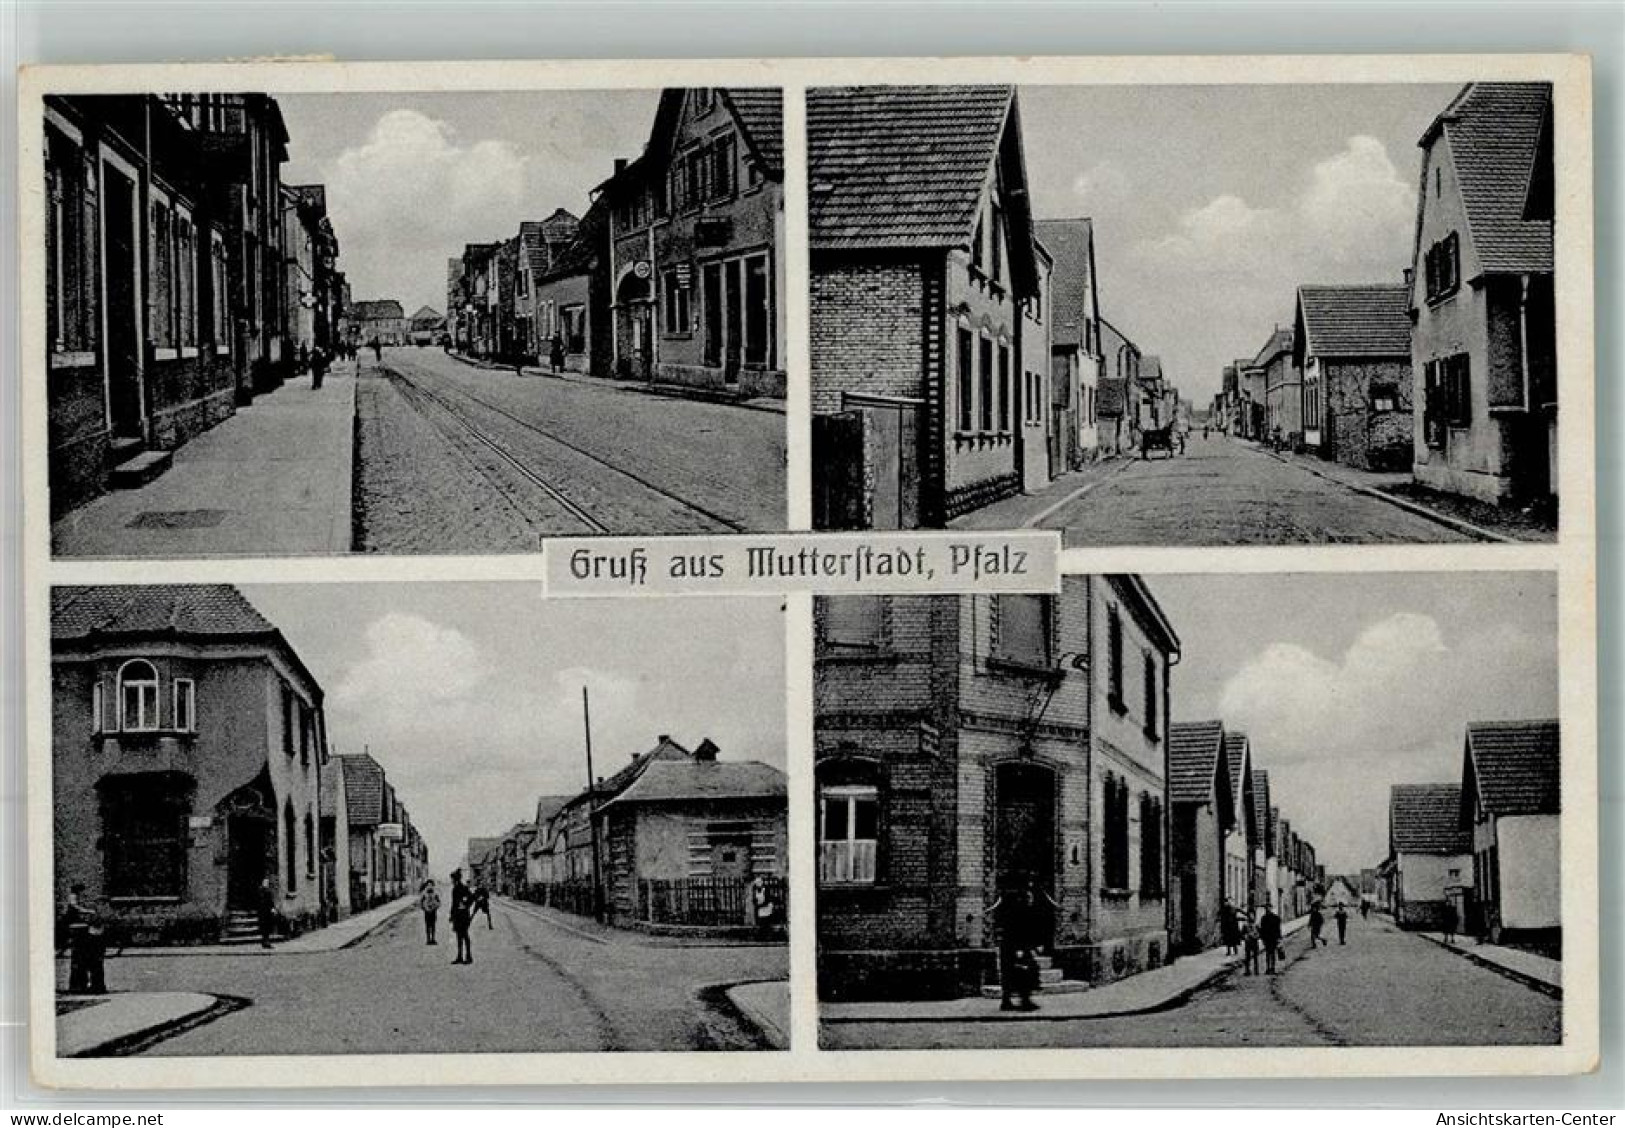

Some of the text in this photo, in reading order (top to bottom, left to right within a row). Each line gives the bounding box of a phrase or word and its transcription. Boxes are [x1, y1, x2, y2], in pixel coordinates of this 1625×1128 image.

[570, 547, 648, 585] Gruß
[670, 554, 724, 578] aus
[949, 544, 1028, 581] Pfalz
